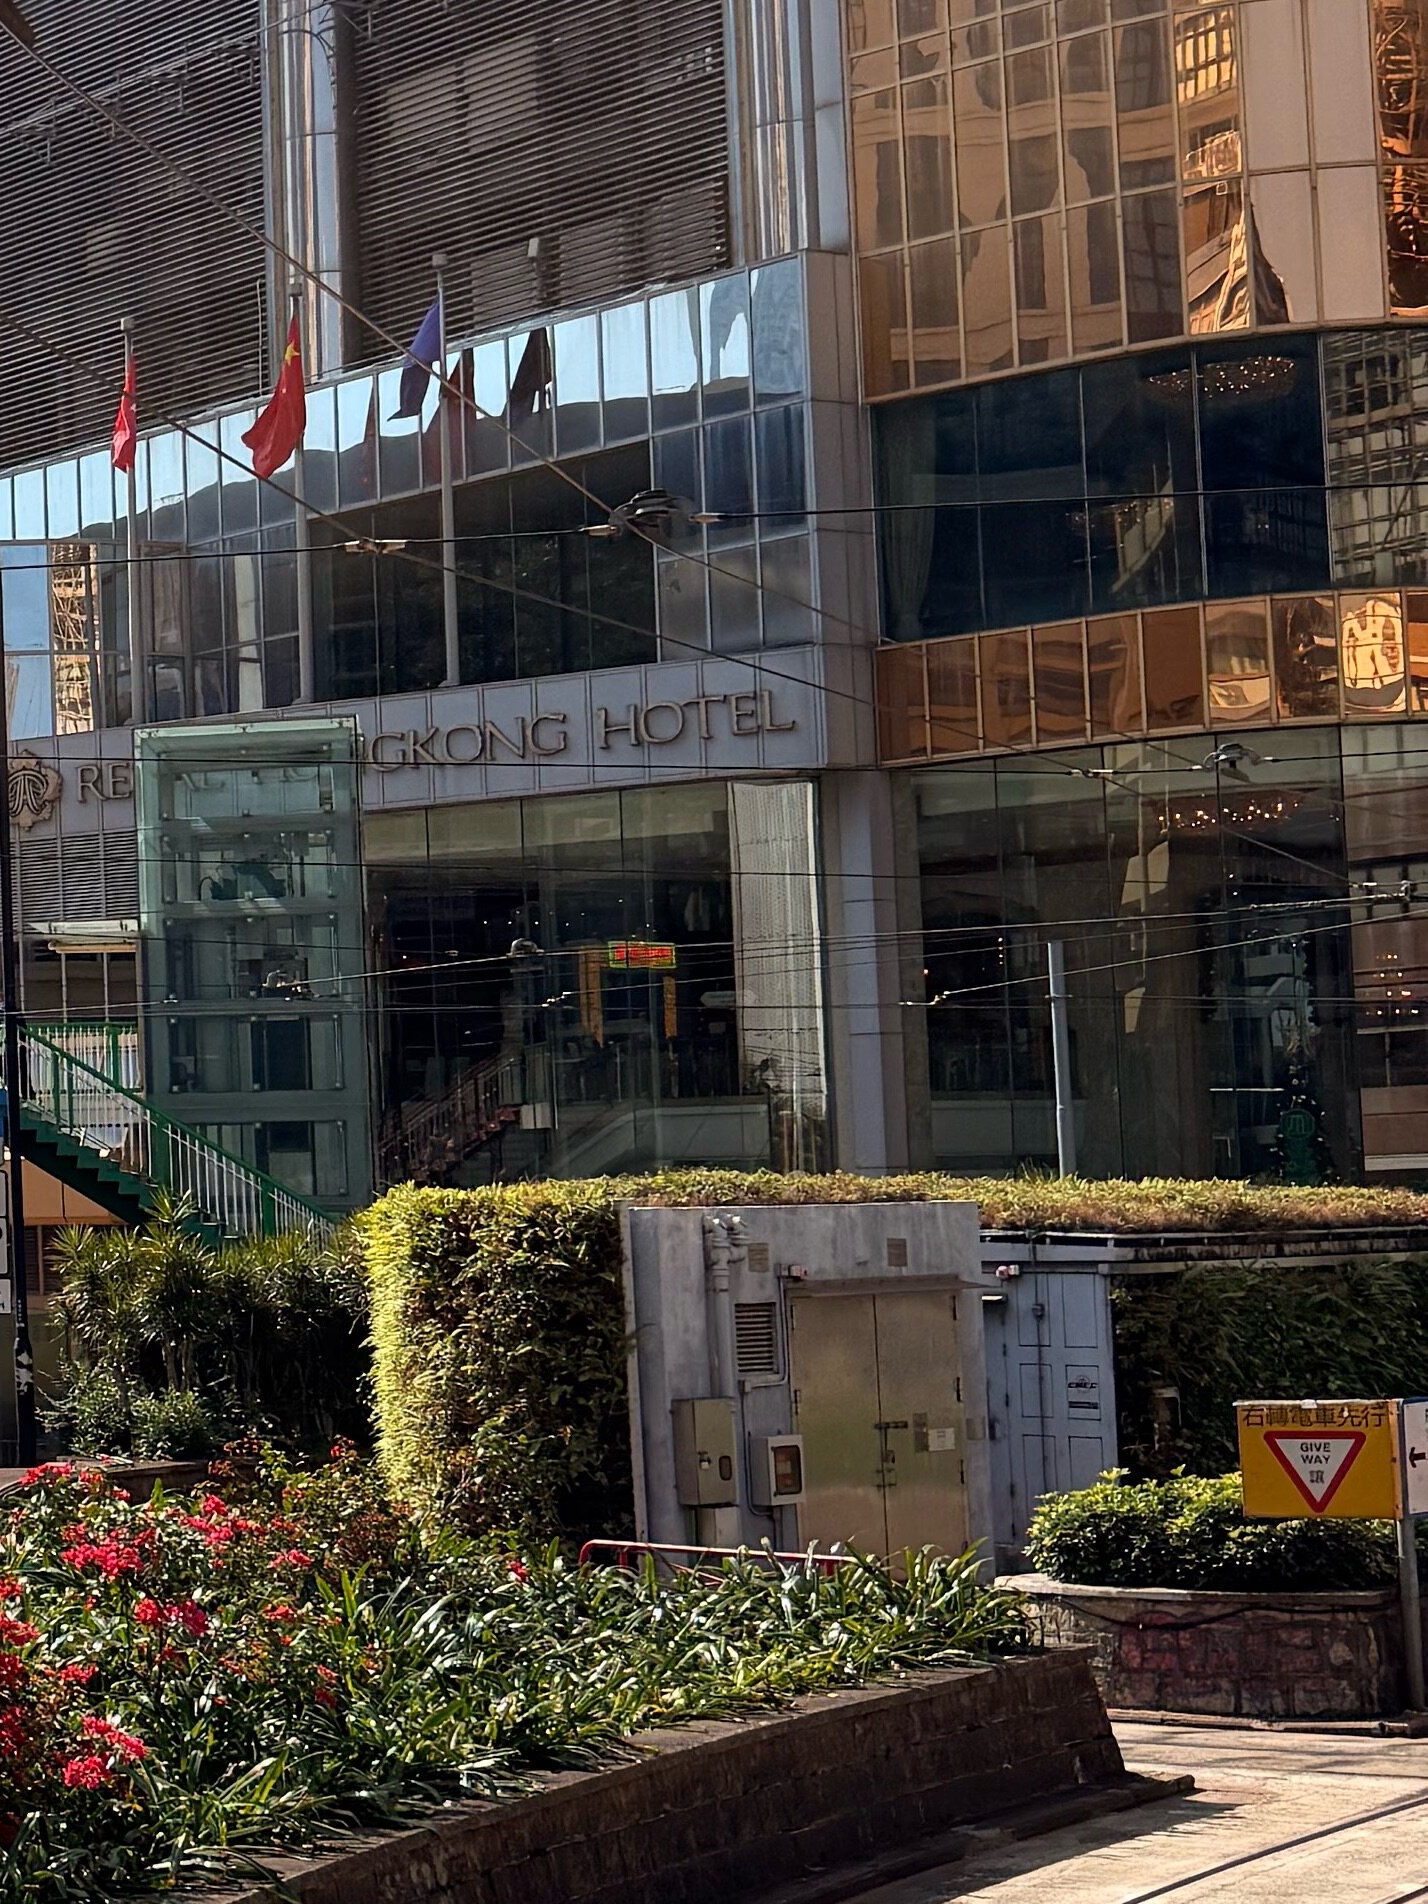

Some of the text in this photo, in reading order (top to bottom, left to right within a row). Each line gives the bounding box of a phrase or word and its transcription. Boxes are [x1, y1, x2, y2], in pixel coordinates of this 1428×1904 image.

[597, 688, 797, 751] HOTEL
[1300, 1441, 1331, 1453] GIVE
[1300, 1454, 1331, 1465] WAY
